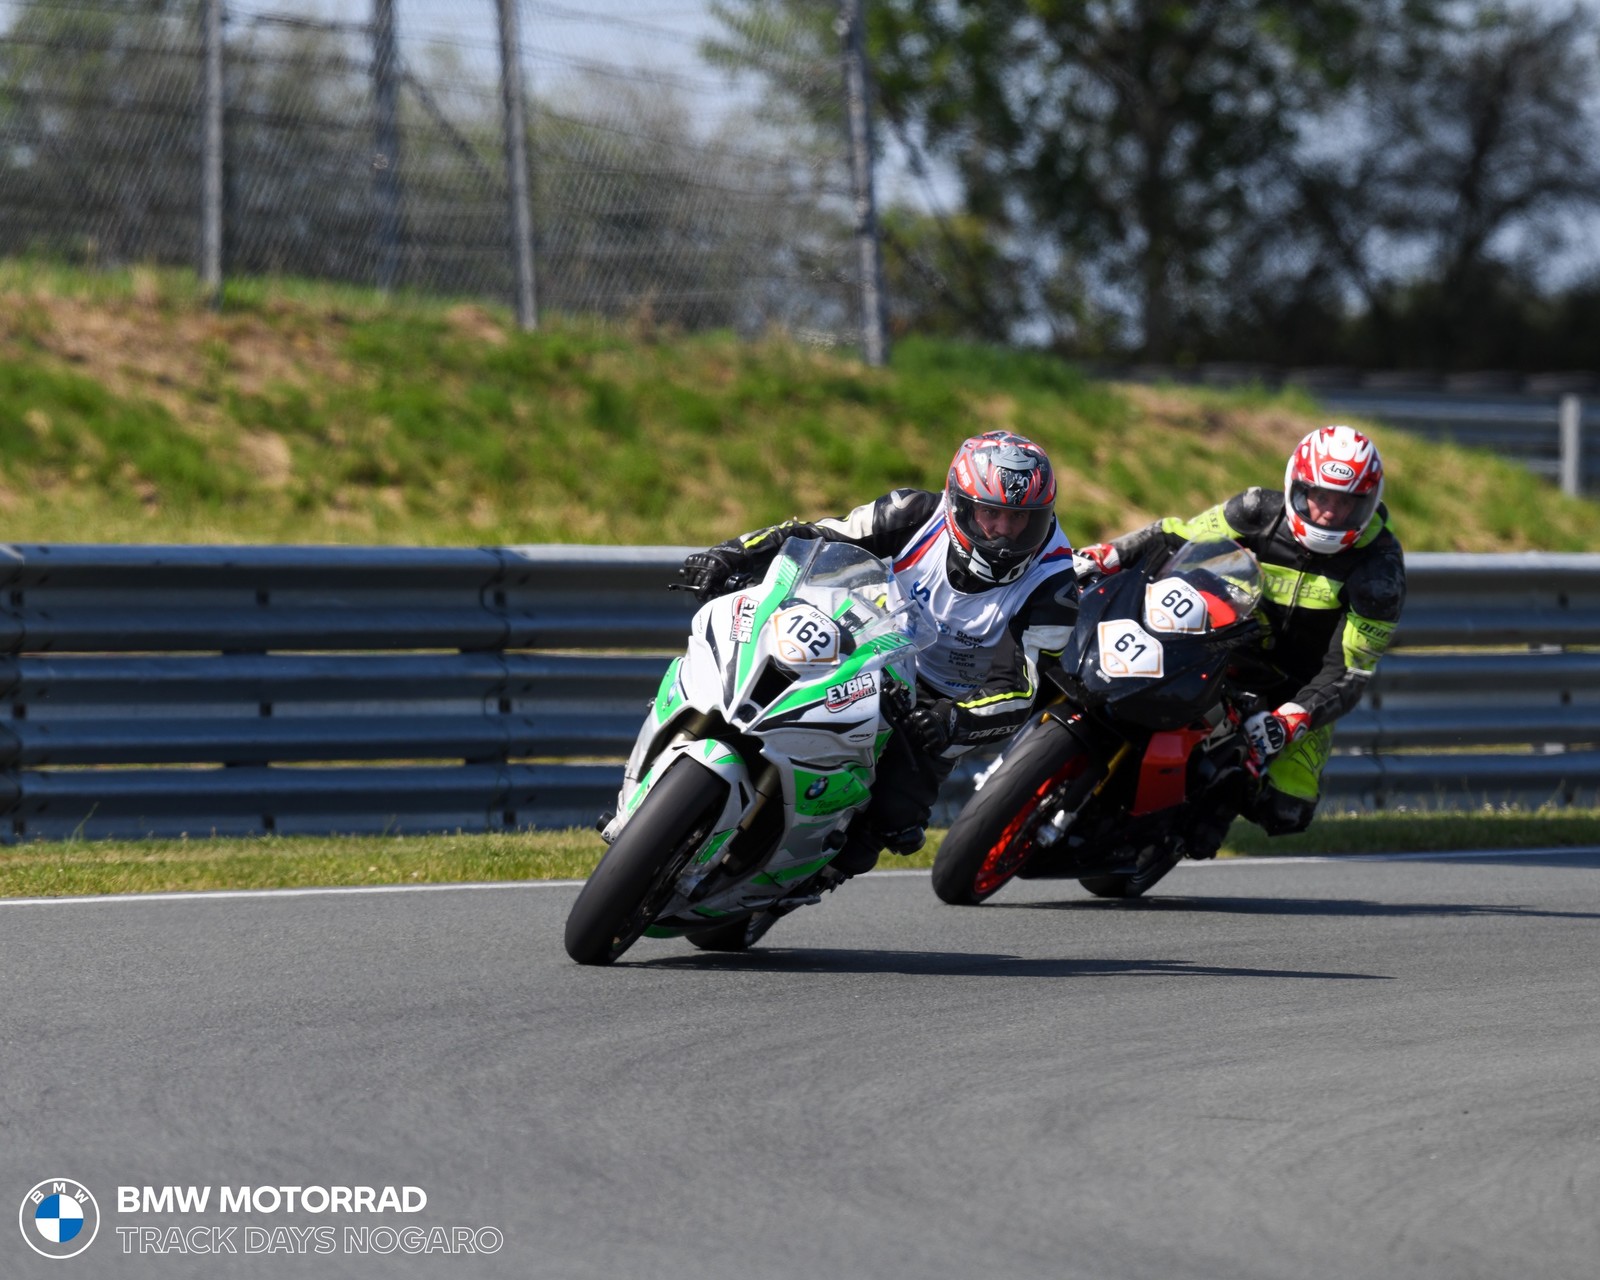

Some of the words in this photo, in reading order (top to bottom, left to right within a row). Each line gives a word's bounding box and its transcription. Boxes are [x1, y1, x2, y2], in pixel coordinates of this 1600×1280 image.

[1329, 463, 1350, 476] Arai
[1161, 589, 1194, 618] 60
[740, 600, 759, 643] EYBIS
[786, 614, 831, 657] 162
[787, 647, 797, 655] 7
[957, 630, 984, 644] BMW
[1114, 633, 1147, 662] 61
[950, 651, 975, 659] MAKE
[826, 673, 874, 702] EYBIS
